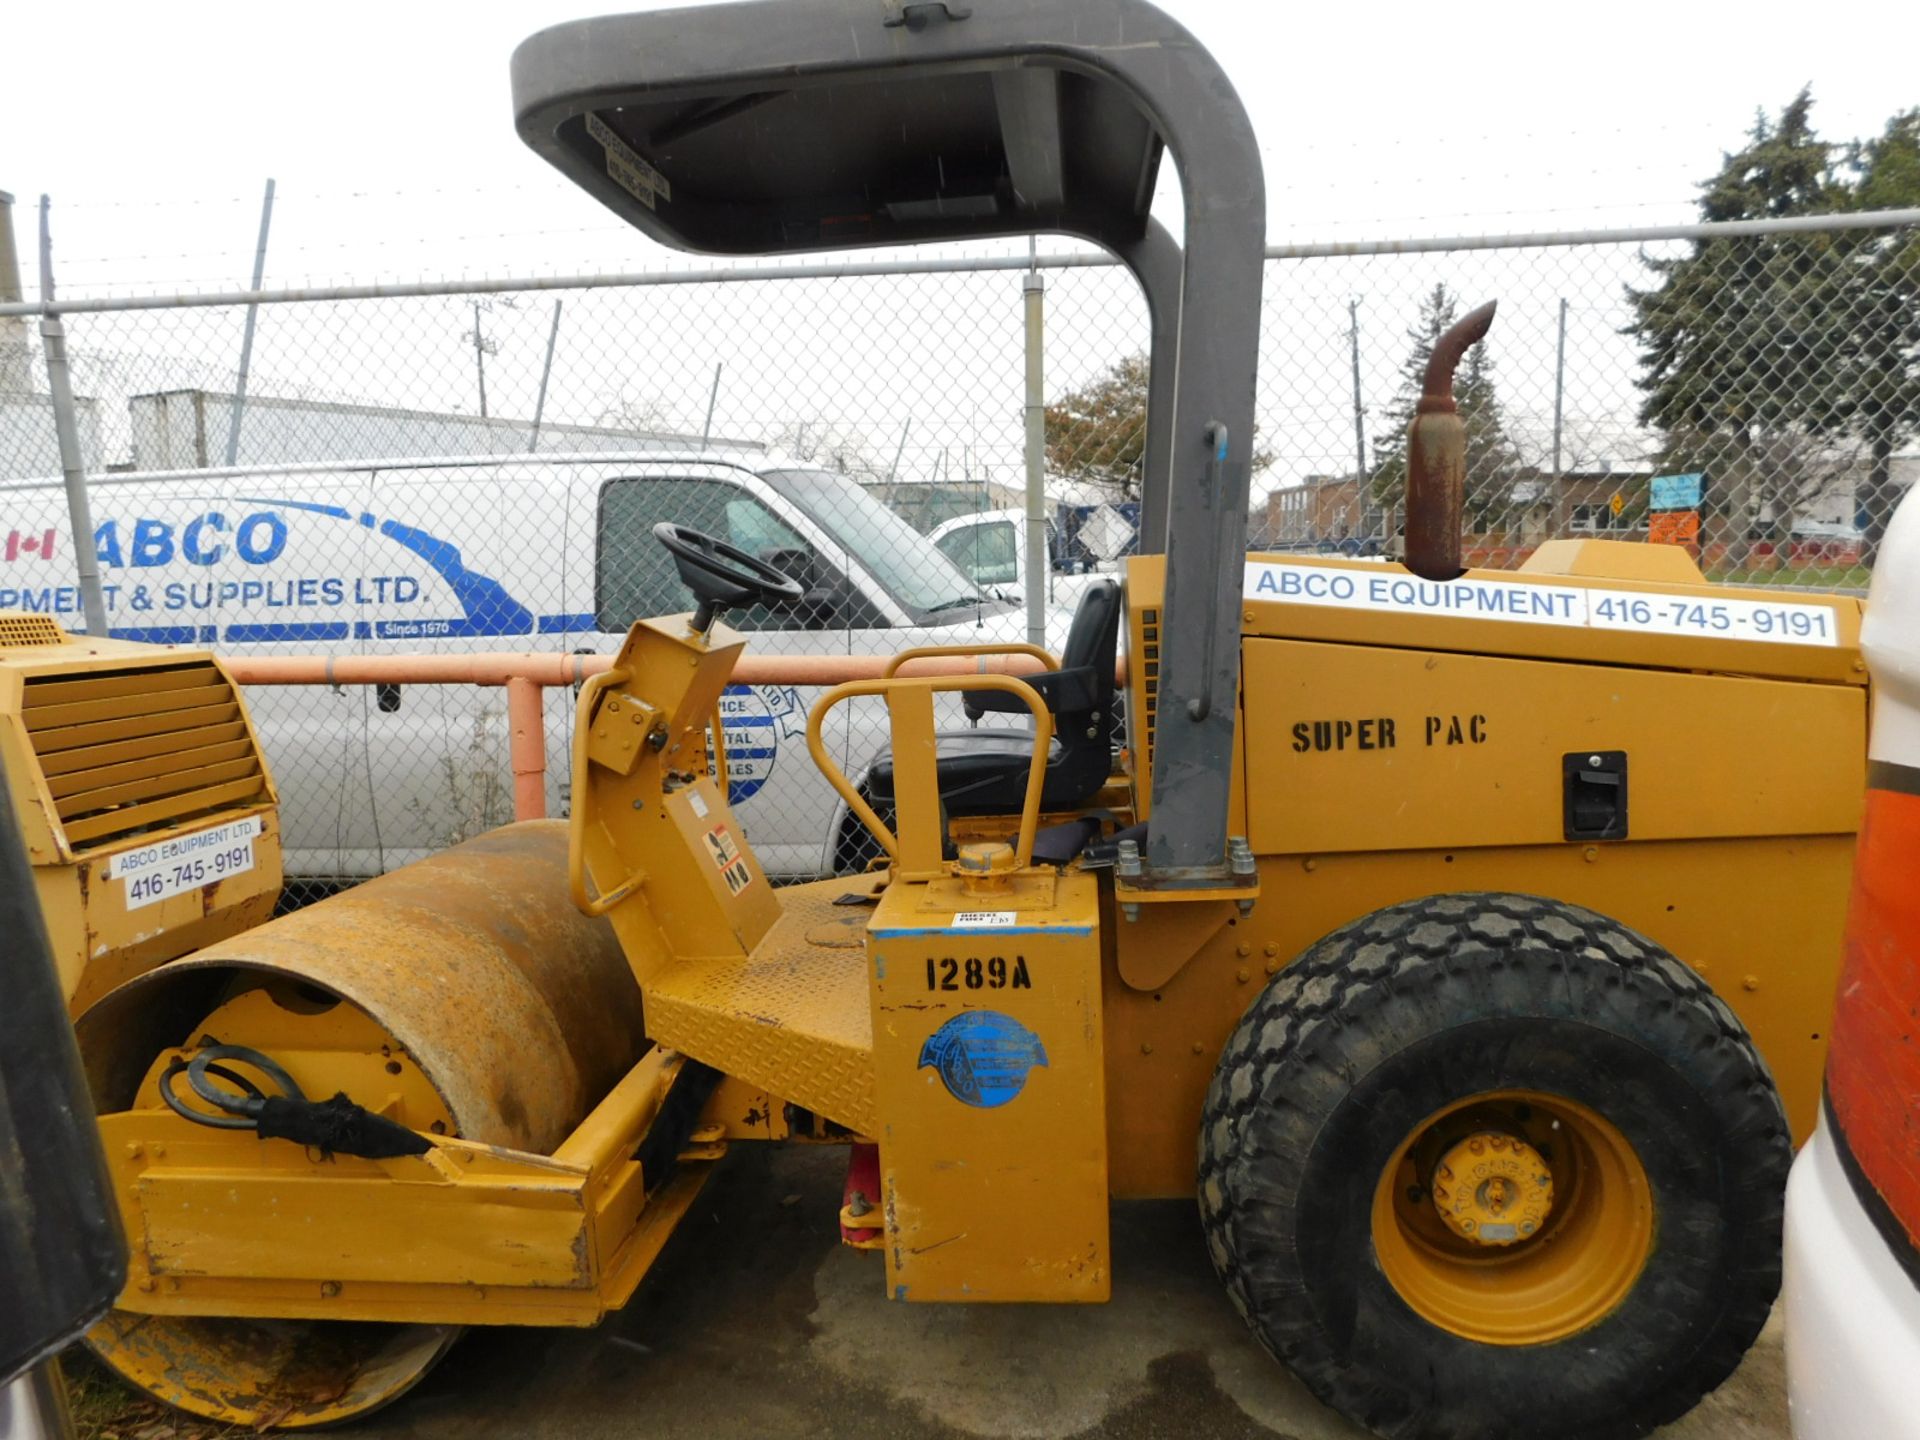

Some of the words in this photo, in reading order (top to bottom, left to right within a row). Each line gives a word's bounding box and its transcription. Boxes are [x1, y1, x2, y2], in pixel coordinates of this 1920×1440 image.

[94, 511, 288, 568] ABCO
[131, 585, 153, 611] &
[164, 577, 344, 611] SUPPLIES
[355, 576, 430, 604] LTD.
[1256, 570, 1354, 600] ABCO
[1369, 578, 1576, 618] EQUIPMENT
[1595, 597, 1826, 638] 416-745-9191
[385, 623, 418, 635] Since
[421, 622, 449, 634] 1970
[719, 701, 746, 712] ICE
[1292, 718, 1395, 753] SUPER
[1425, 714, 1487, 746] PAC
[708, 763, 753, 775] SLES
[120, 848, 158, 872] ABCO
[162, 827, 229, 860] EQUIPMENT
[233, 822, 254, 839] LTD.
[130, 845, 251, 900] 416-745-9191
[927, 955, 1032, 992] 1289A
